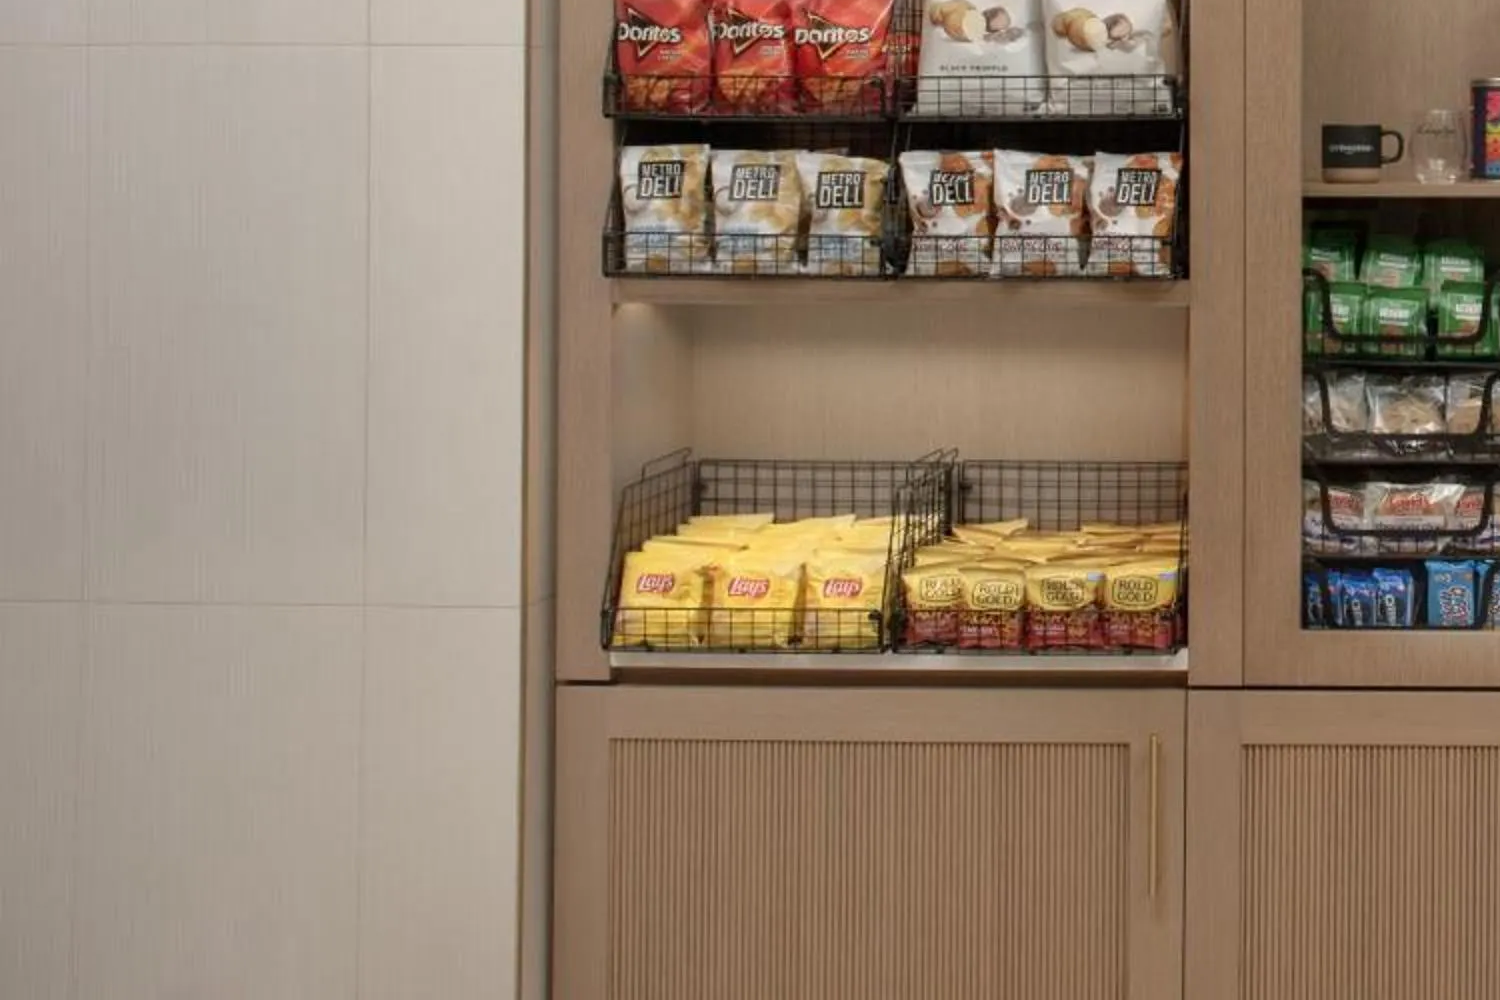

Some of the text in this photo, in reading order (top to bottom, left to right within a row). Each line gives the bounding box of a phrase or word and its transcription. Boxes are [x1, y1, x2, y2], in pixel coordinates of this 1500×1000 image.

[795, 27, 870, 45] Doritos
[642, 163, 682, 176] METRO
[1030, 171, 1070, 182] METRO
[1120, 171, 1157, 182] METRO
[640, 177, 680, 198] DELI
[821, 173, 861, 185] METRO
[733, 179, 777, 200] DELI
[819, 186, 862, 207] DELI
[932, 183, 973, 204] DELI
[1028, 183, 1071, 204] DELI
[1118, 182, 1156, 203] DELI
[1119, 580, 1153, 591] ROLD
[1118, 591, 1153, 602] GOLD
